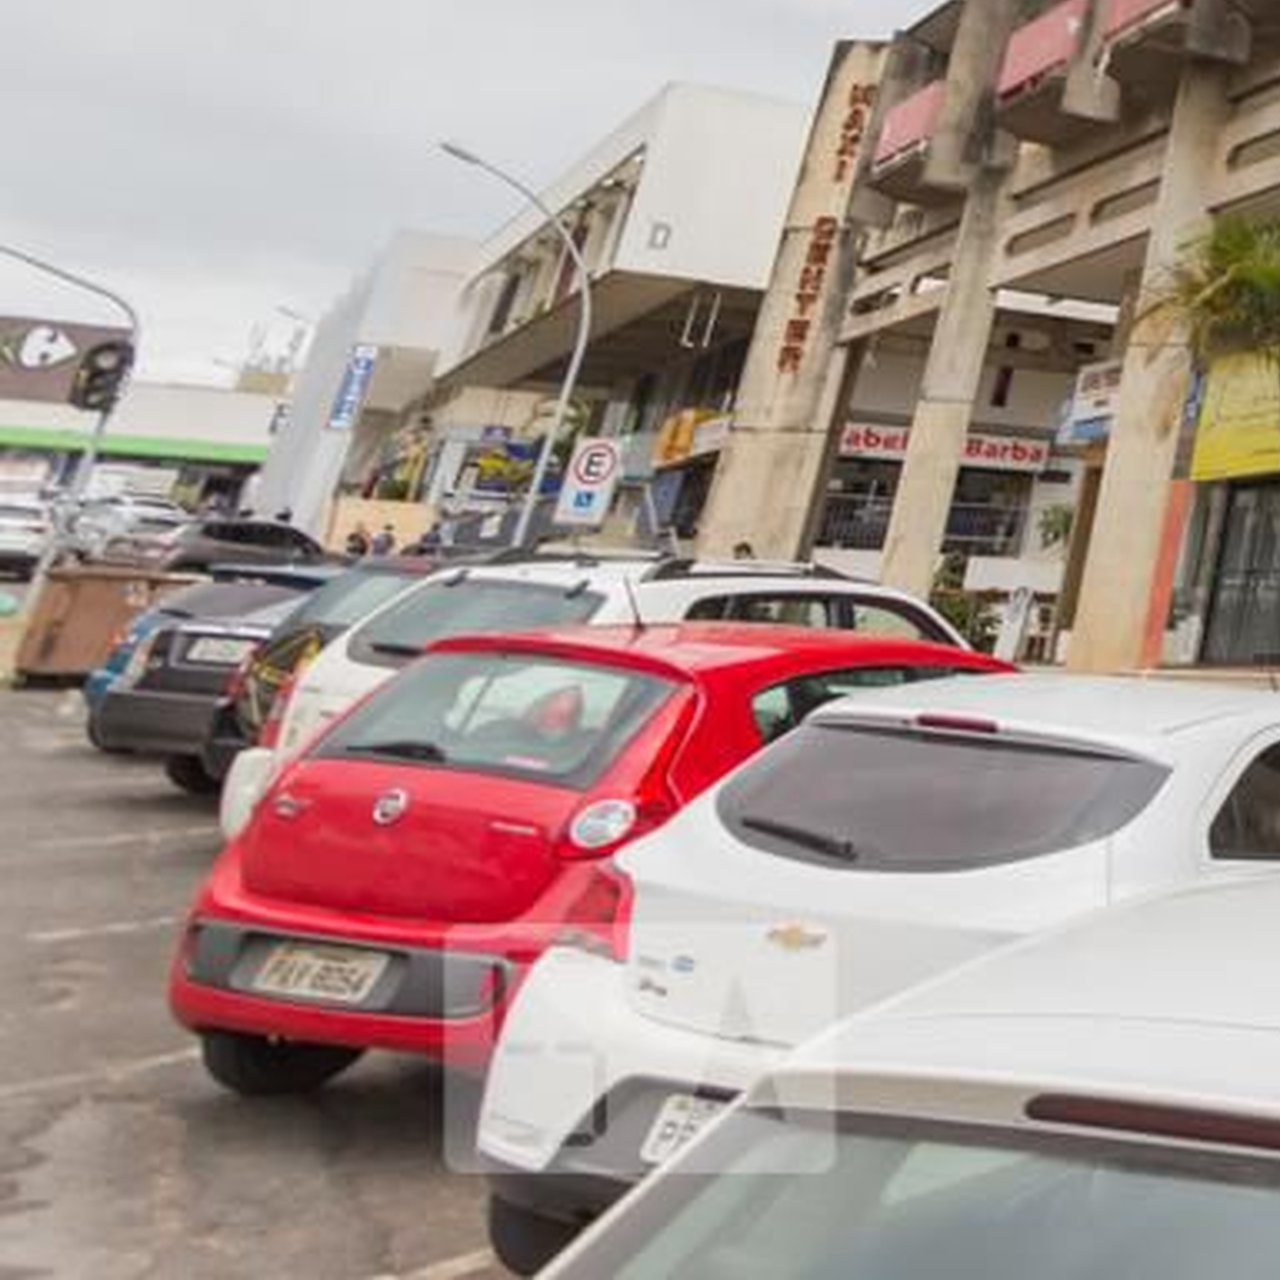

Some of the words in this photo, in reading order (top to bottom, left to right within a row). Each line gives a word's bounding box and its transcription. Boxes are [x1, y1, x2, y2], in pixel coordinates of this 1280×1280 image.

[778, 216, 836, 373] CENTER
[965, 437, 1043, 463] Barba
[584, 452, 608, 477] E
